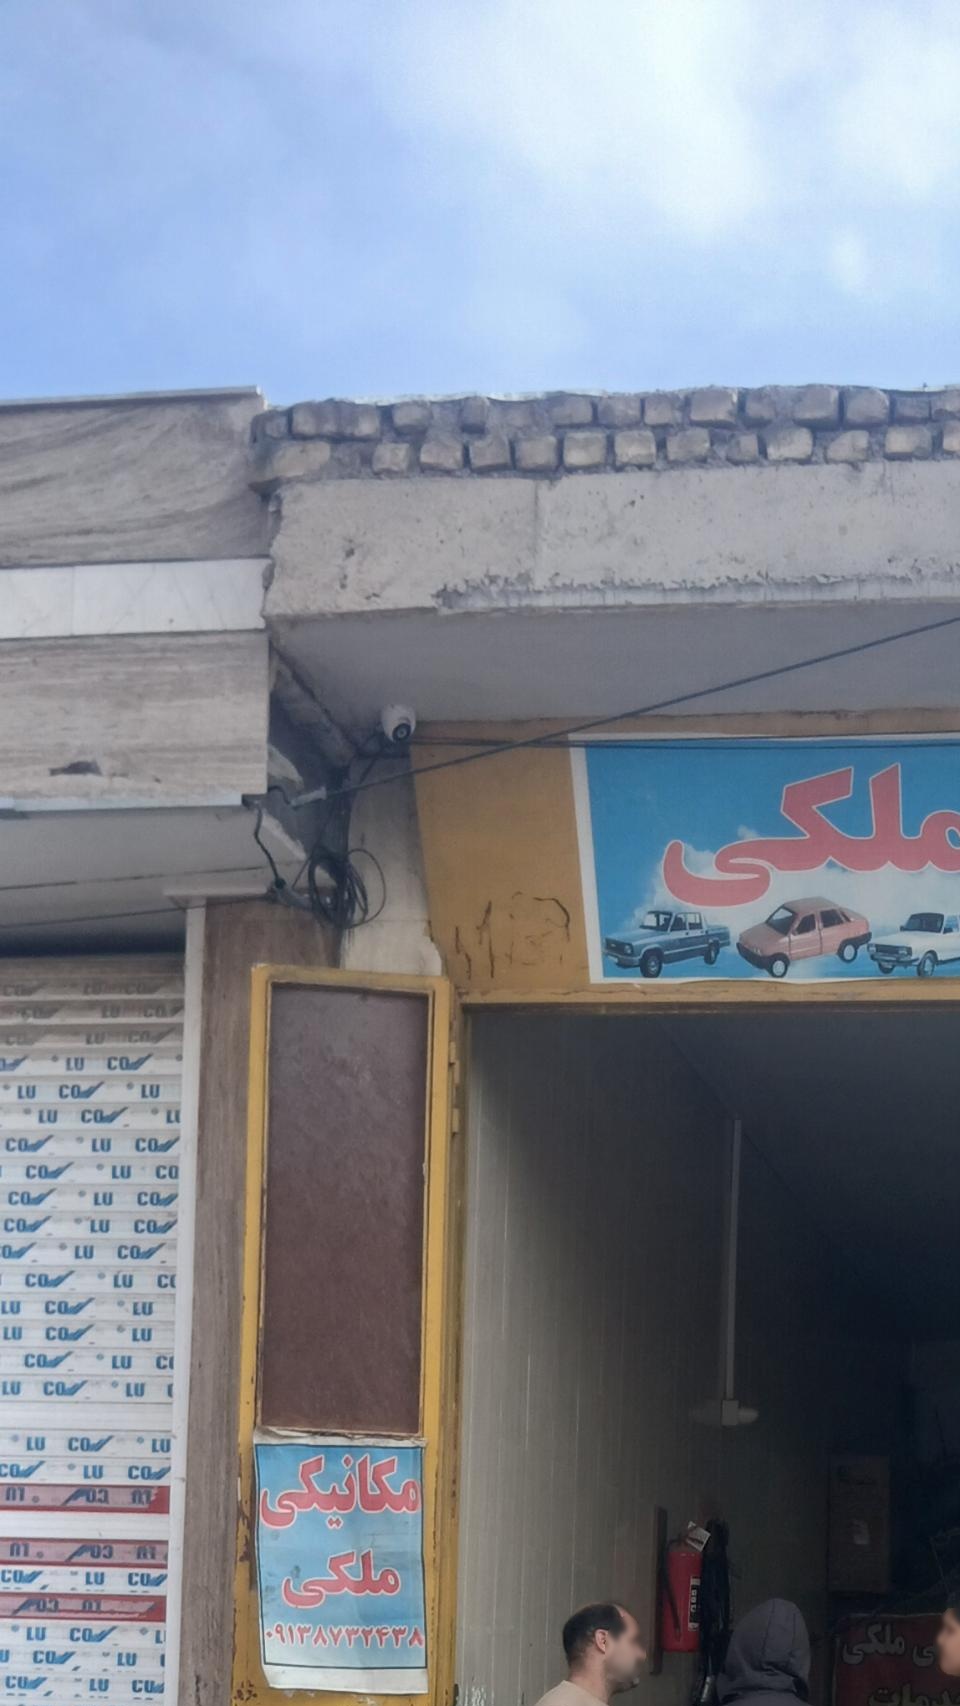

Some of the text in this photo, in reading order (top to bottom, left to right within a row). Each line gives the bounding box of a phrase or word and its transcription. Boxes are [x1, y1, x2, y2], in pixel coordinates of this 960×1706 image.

[260, 1453, 422, 1530] مکانیکی
[281, 1548, 402, 1610] ملکی
[265, 1622, 425, 1649] ۰۹۱۳۸۷۳۲۴۳۸
[842, 1623, 906, 1665] ملکی
